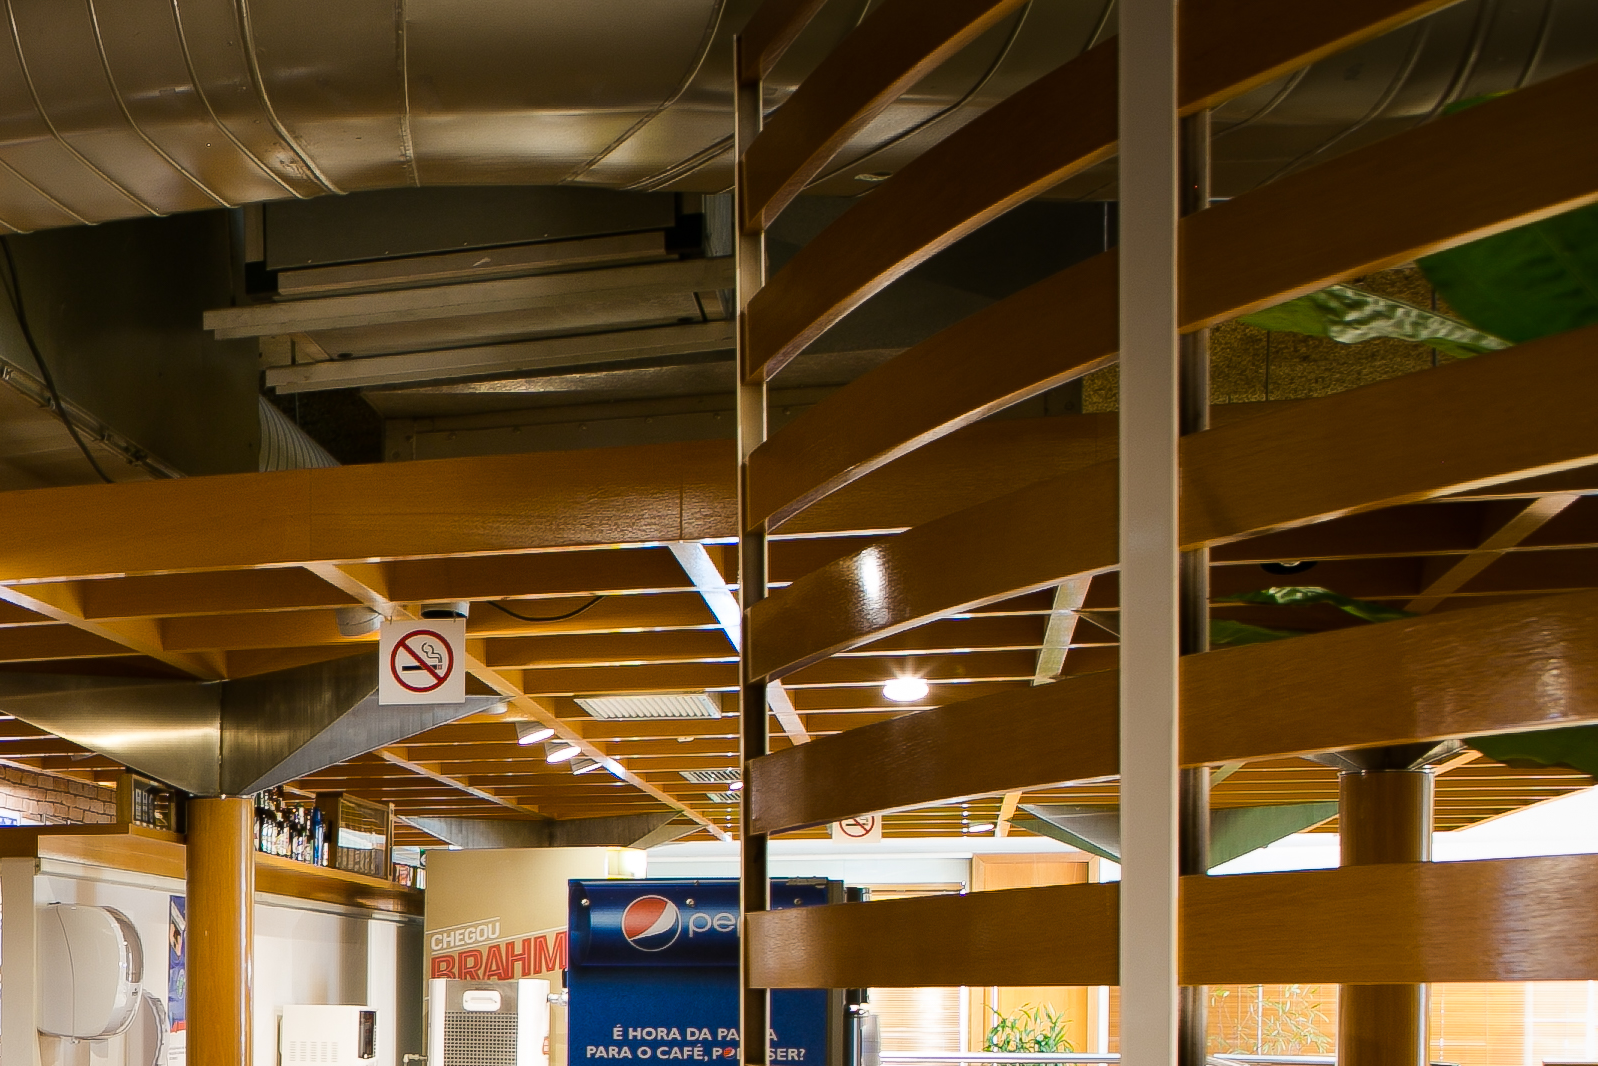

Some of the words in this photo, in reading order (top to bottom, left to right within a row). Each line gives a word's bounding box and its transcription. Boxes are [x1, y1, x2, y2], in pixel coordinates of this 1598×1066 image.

[430, 921, 501, 951] CHEGOU
[430, 930, 568, 981] BRAHM
[612, 1024, 623, 1040] É
[628, 1027, 682, 1041] HORA
[686, 1027, 712, 1041] DA
[717, 1028, 778, 1041] PAA
[586, 1045, 633, 1059] PARA
[637, 1046, 652, 1059] O
[656, 1044, 709, 1062] CAFÉ,
